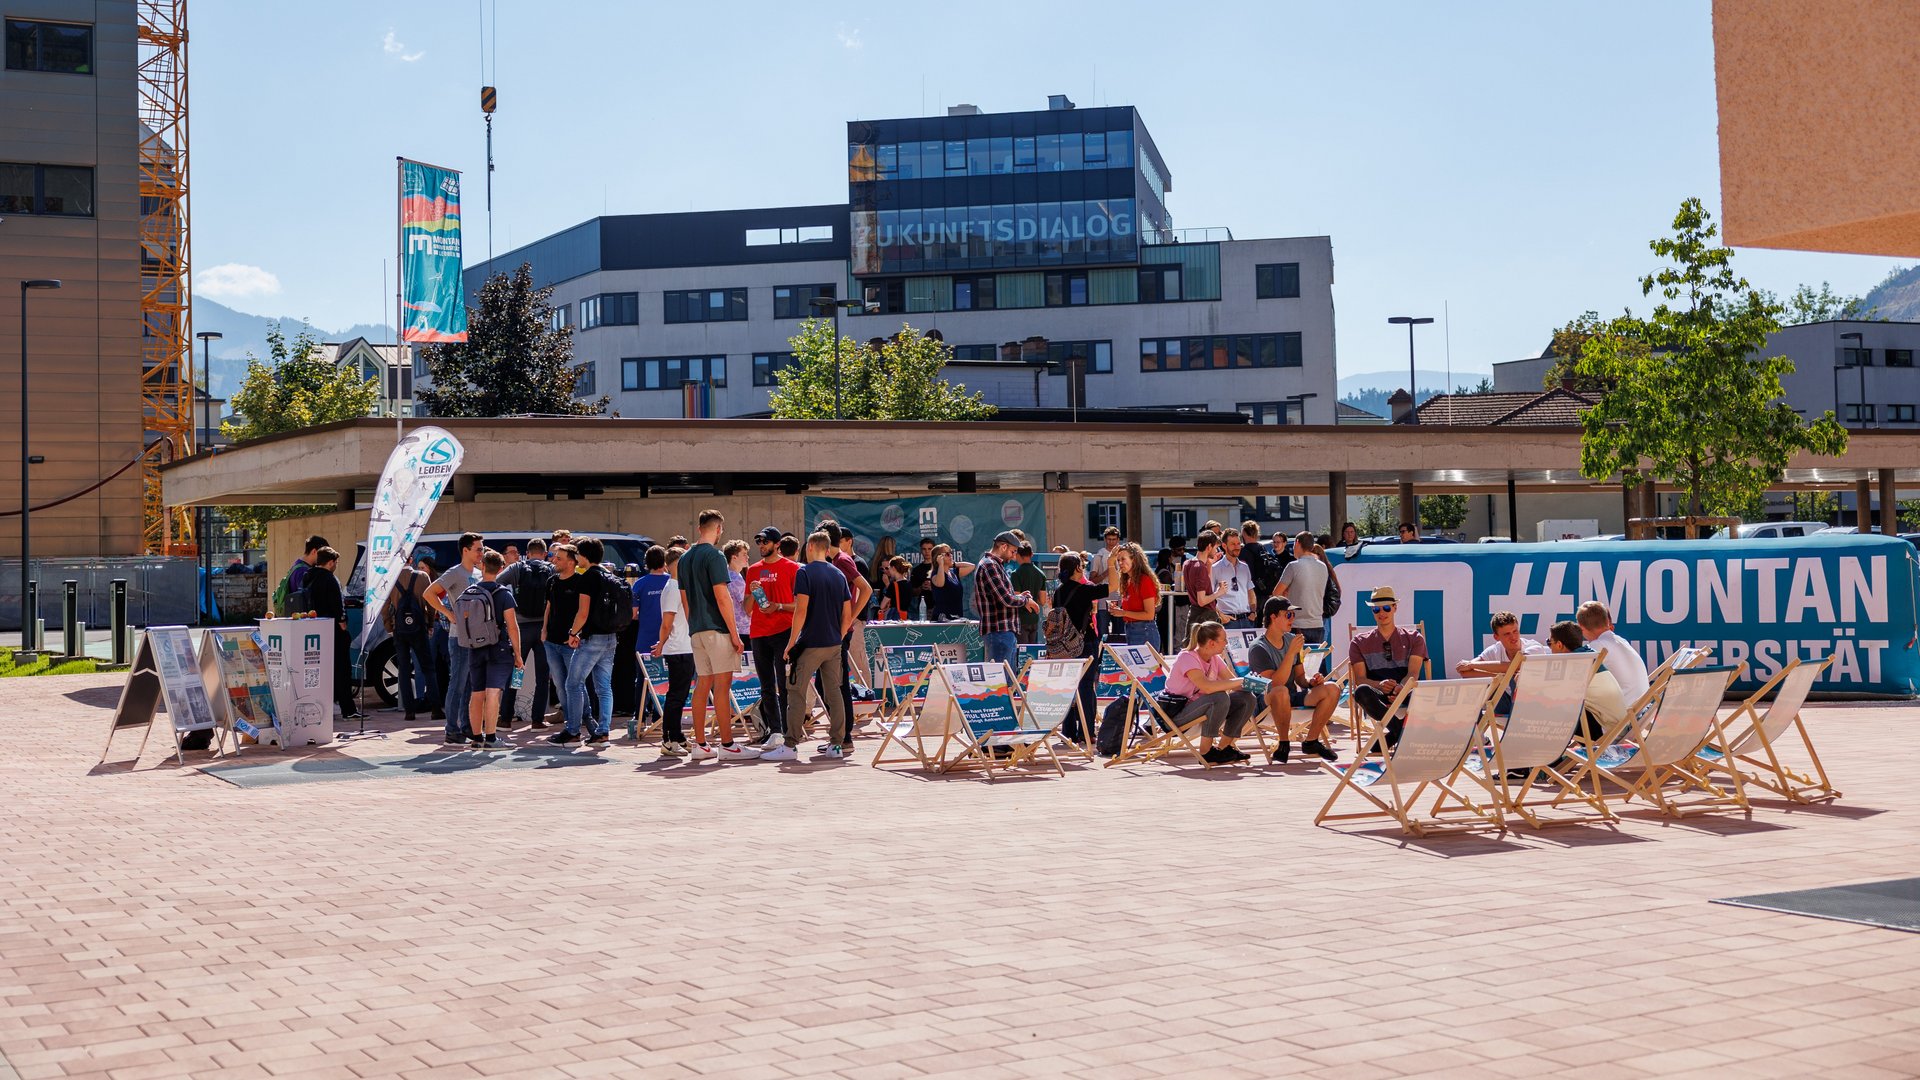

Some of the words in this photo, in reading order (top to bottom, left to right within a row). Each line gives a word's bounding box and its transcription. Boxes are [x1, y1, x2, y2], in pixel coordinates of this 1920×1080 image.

[433, 235, 460, 246] MONTAN
[856, 212, 1131, 248] ZUKUNFTSDIALOG
[419, 465, 452, 475] LEOBEN
[1631, 628, 1889, 684] IVERSITÄT
